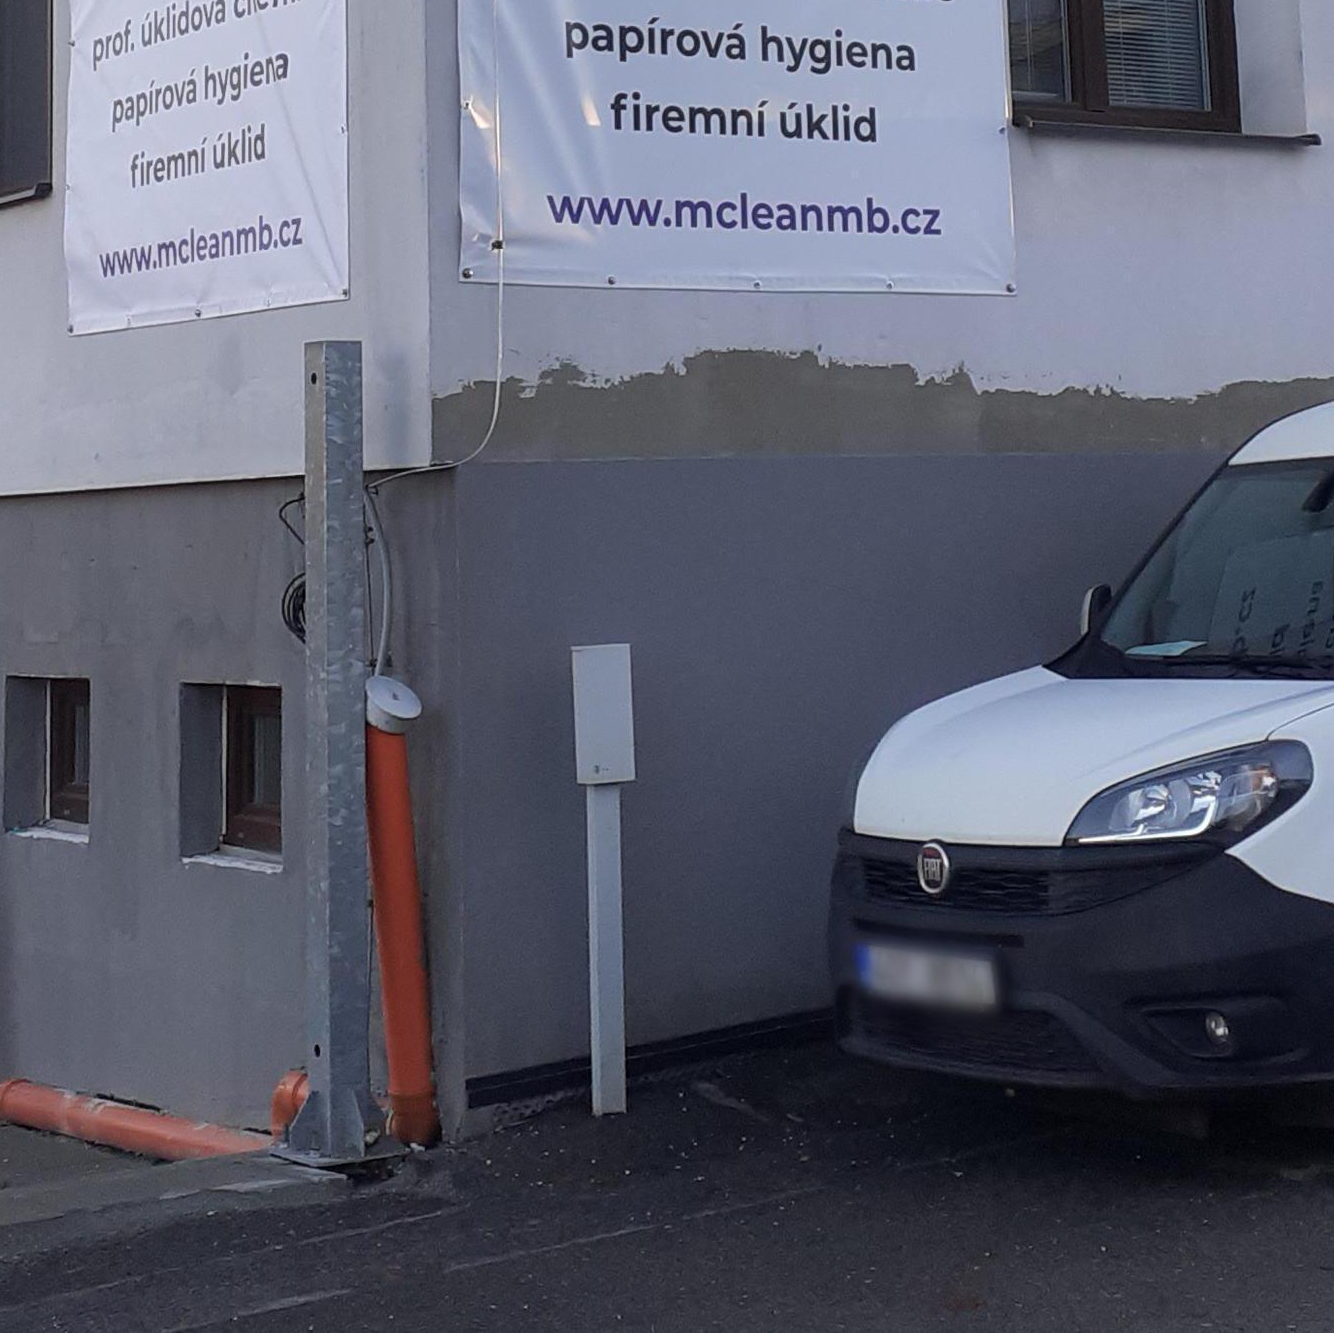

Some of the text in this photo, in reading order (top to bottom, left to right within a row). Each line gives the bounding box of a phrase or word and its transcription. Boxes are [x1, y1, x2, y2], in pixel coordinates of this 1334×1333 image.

[92, 19, 135, 72] prof.
[563, 12, 917, 75] papírová hygiena
[112, 52, 289, 133] papírová hygiena
[610, 92, 878, 144] firemní úklid
[130, 123, 266, 189] firemní úklid
[99, 215, 304, 278] www.mcleanmb.cz
[546, 193, 943, 237] www.mcleanmb.cz
